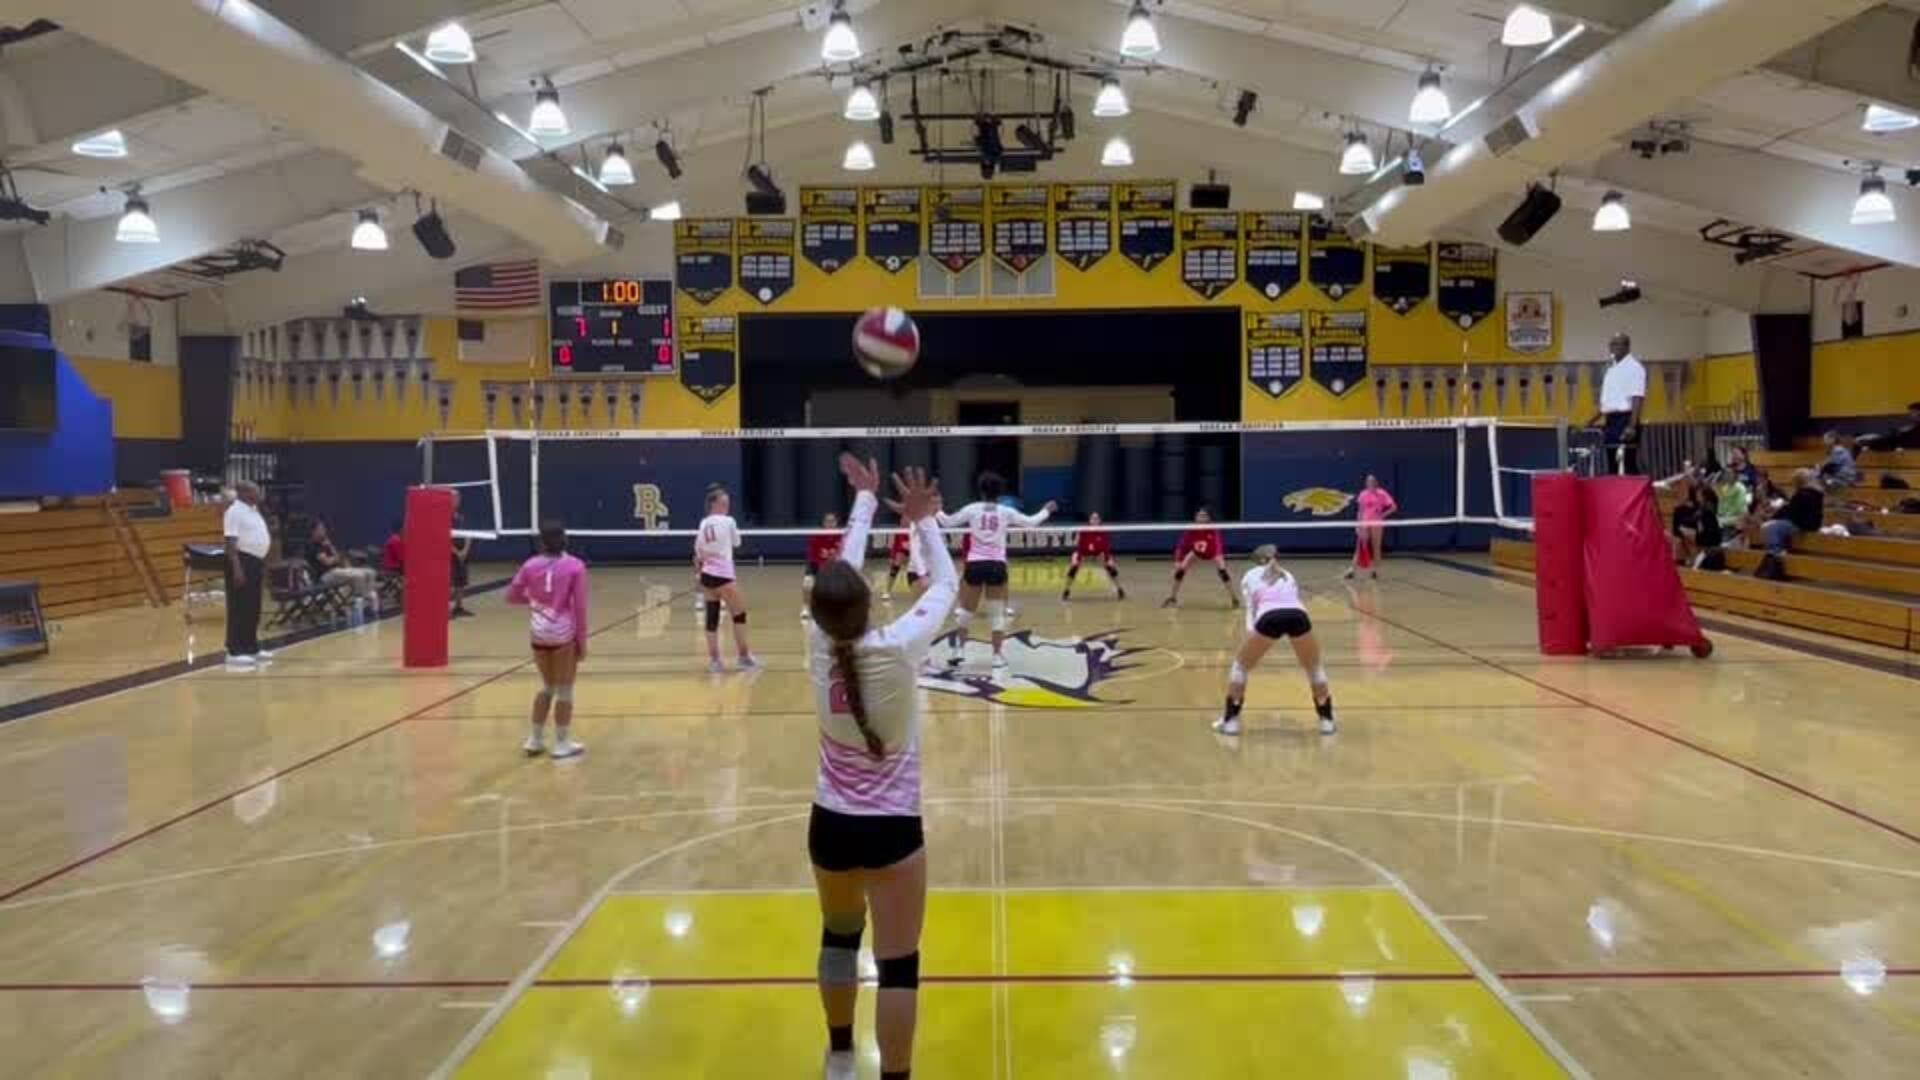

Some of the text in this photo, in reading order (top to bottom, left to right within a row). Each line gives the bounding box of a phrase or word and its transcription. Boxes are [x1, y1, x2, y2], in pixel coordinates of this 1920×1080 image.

[559, 345, 571, 364] 0
[658, 345, 671, 364] 0
[544, 570, 553, 593] 1
